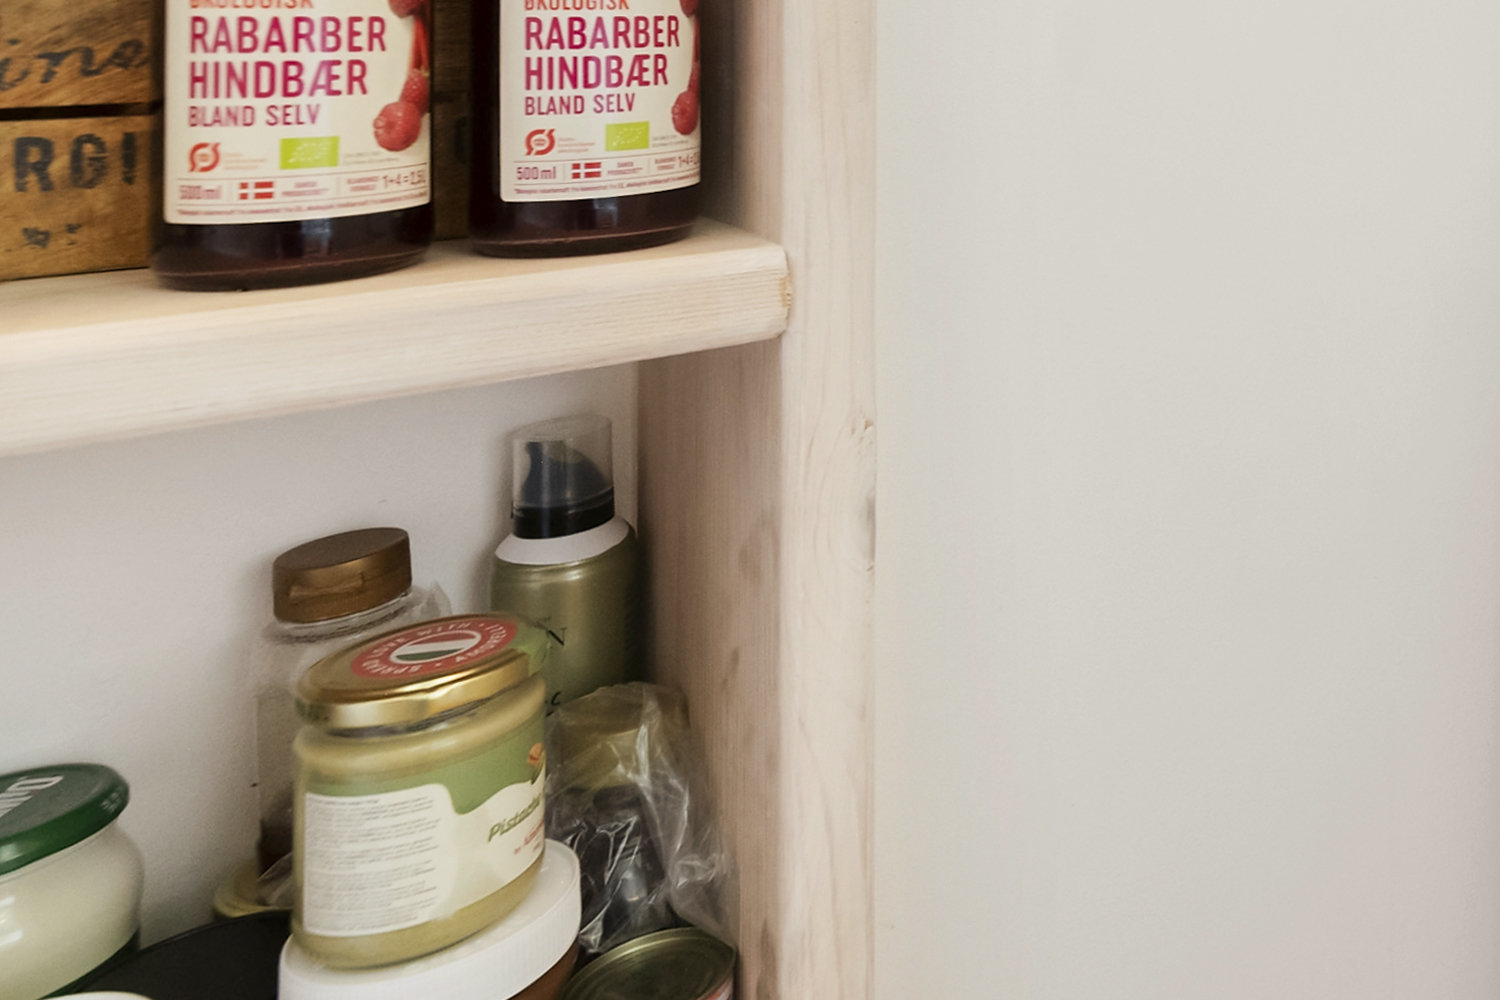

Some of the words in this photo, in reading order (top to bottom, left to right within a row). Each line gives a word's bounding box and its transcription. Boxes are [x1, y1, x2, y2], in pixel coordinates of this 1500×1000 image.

[190, 15, 386, 53] RABARBER
[525, 15, 680, 50] RABARBER
[189, 59, 368, 99] HINDBÆR
[524, 54, 668, 91] HINDBÆR
[188, 104, 255, 127] BLAND
[266, 103, 321, 126] SELV
[524, 95, 585, 115] BLAND
[593, 93, 636, 114] SELV
